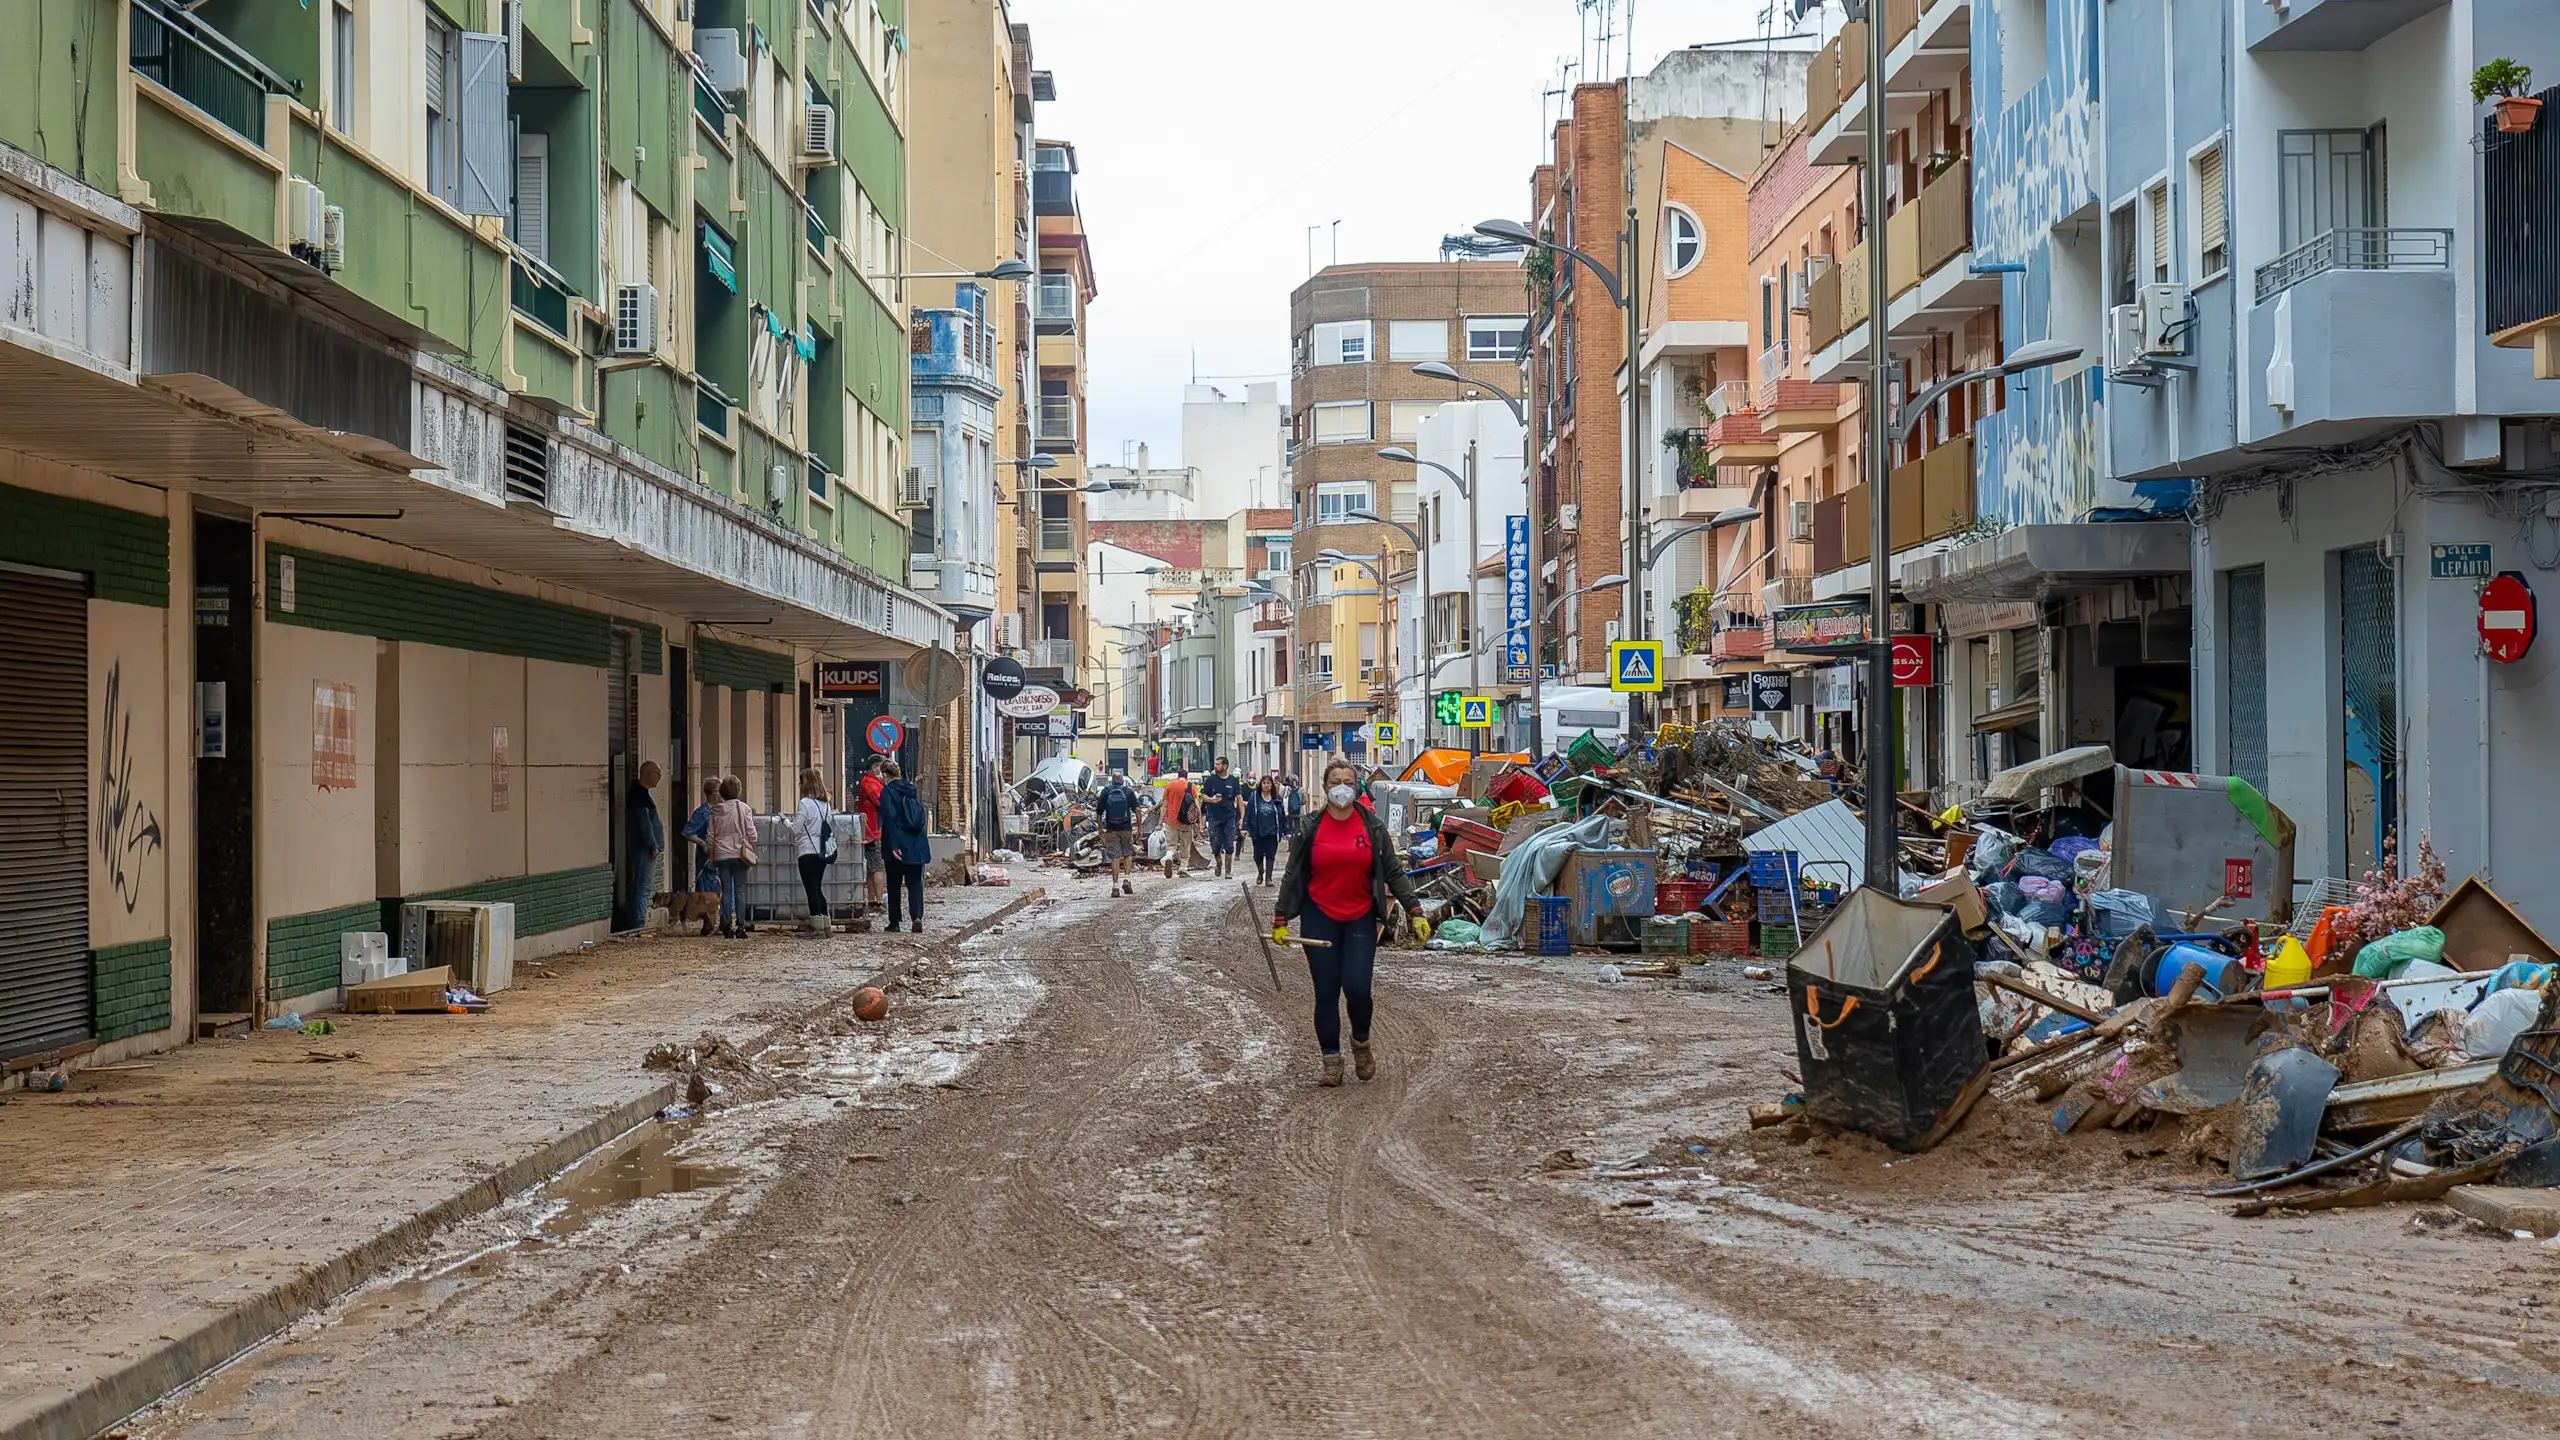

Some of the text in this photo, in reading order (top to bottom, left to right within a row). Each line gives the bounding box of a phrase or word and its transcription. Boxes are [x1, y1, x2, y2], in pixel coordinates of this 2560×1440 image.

[2448, 546, 2481, 555] CALLE
[2441, 560, 2490, 575] LEPANTO
[1509, 517, 1527, 646] TINTORERIA
[1776, 619, 1808, 639] FRUTAS
[1810, 619, 1818, 637] Y
[1818, 615, 1861, 637] VERDURAS
[824, 670, 879, 685] KUUPS
[1508, 668, 1553, 679] HEROL
[1753, 674, 1789, 684] Gomar
[1004, 694, 1052, 706] DARKNESS
